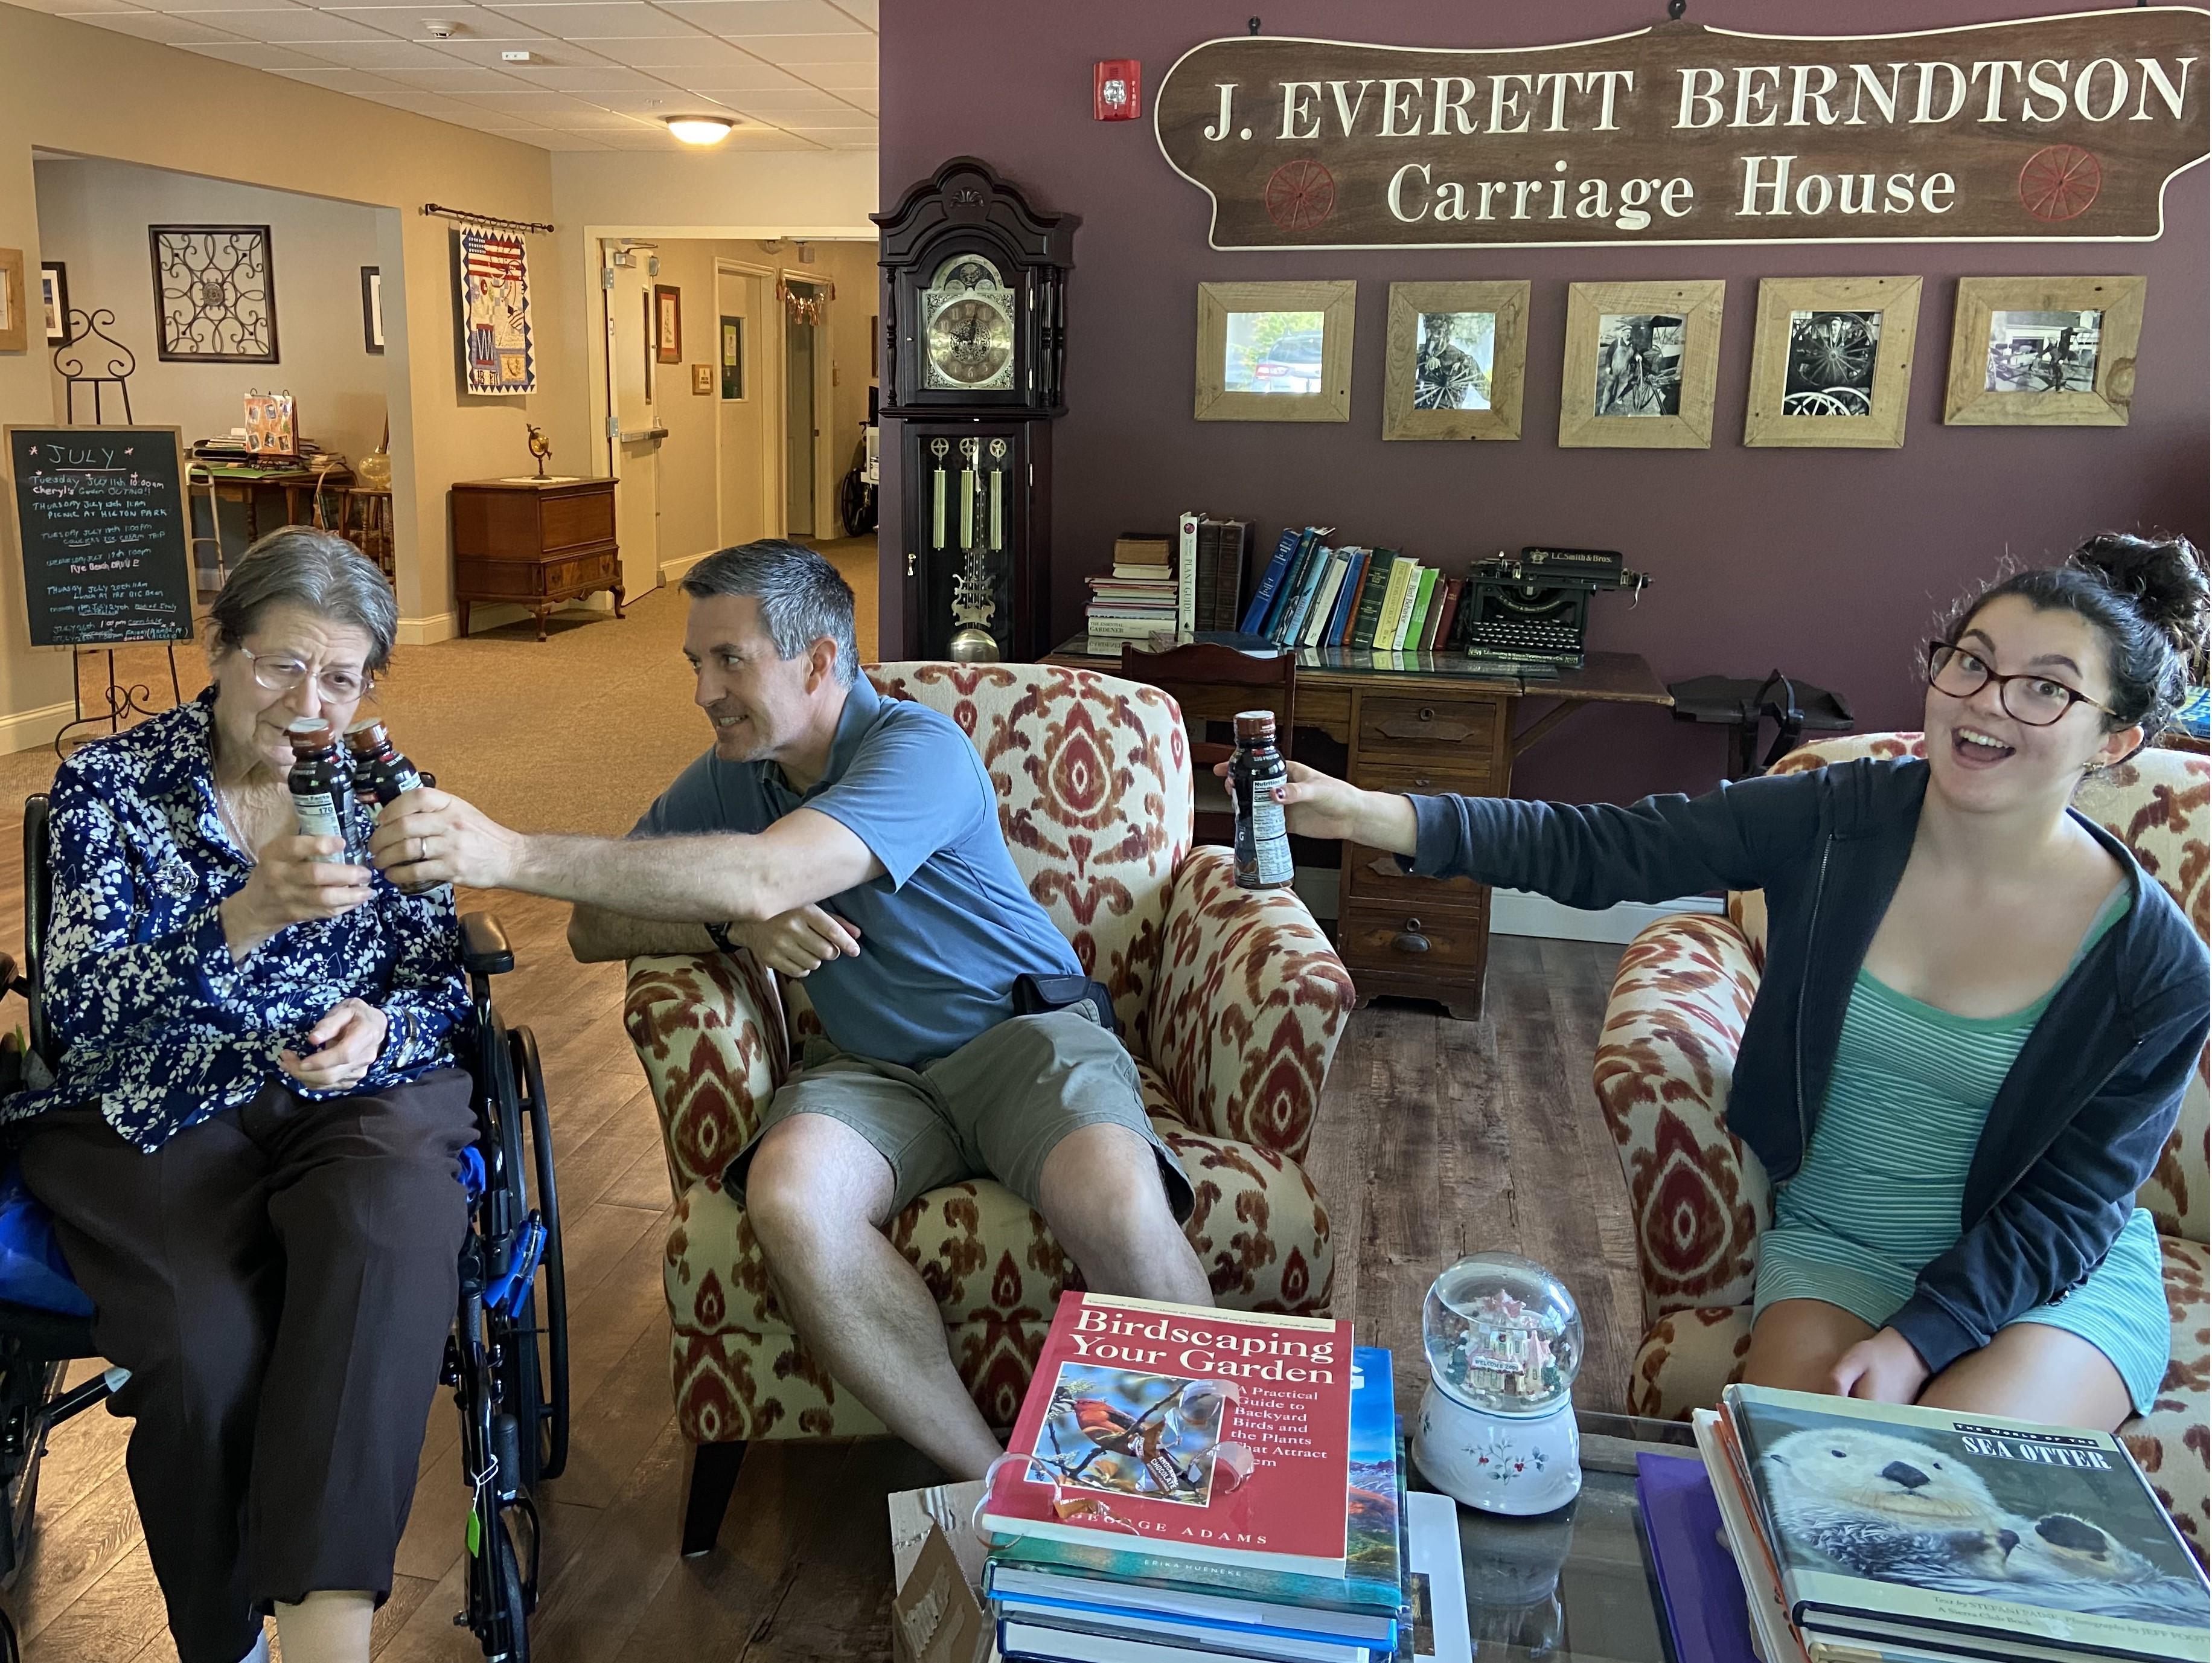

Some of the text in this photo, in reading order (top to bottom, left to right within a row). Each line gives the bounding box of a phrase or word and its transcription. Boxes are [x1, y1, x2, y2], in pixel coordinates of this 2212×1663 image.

[1204, 56, 2199, 141] J. EVERETT BERNDTSON
[1387, 155, 1955, 230] Carriage House
[46, 444, 113, 469] JULY
[30, 475, 79, 489] Tuesday
[33, 485, 74, 498] Cheryl's
[33, 501, 80, 510] THURSDAY
[48, 510, 80, 519] PICNIC
[41, 529, 79, 539] TUESDAY
[70, 564, 86, 573] Rye
[1184, 559, 1192, 585] PLANT
[1405, 583, 1416, 598] Bird
[1183, 587, 1192, 614] GUIDE
[1399, 597, 1413, 624] Behavior
[1073, 1309, 1335, 1365] Birdscaping
[1068, 1333, 1335, 1385] Your Garden
[1238, 1385, 1319, 1400] A Practical
[1239, 1396, 1285, 1409] Guide
[1235, 1406, 1307, 1421] Backyard
[1233, 1417, 1308, 1433] Birds and
[1231, 1430, 1312, 1445] the Plants
[1990, 1429, 2038, 1439] WORLD
[1272, 1446, 1328, 1458] Attract
[1962, 1435, 2112, 1470] SEA OTTER
[1150, 1458, 1177, 1490] CHOCOLATE
[1181, 1527, 1267, 1545] ADAMS
[1144, 1559, 1242, 1577] ERIKA HUENEKE
[1948, 1607, 1977, 1618] Sierra
[2127, 1625, 2140, 1635] by
